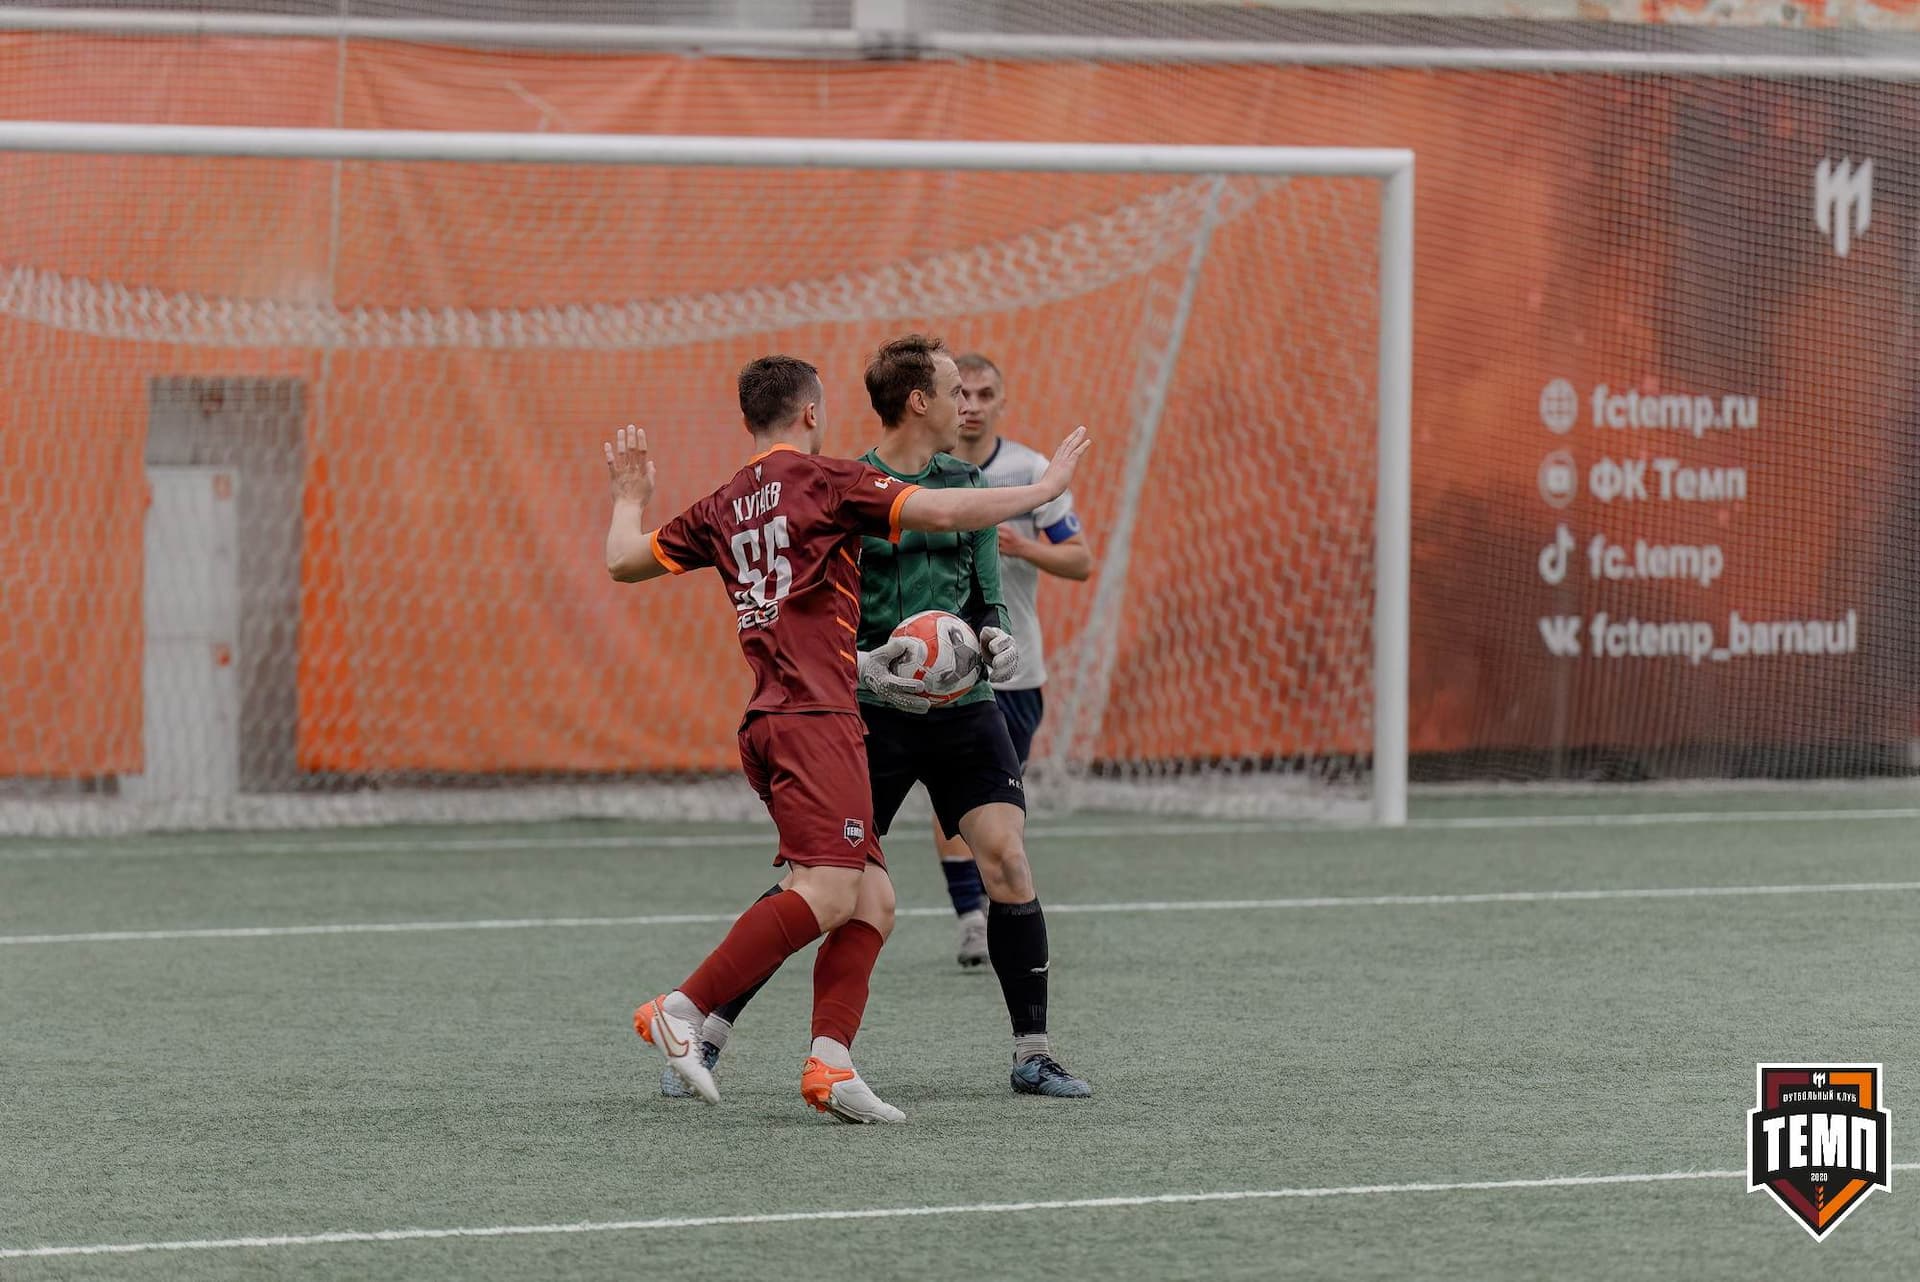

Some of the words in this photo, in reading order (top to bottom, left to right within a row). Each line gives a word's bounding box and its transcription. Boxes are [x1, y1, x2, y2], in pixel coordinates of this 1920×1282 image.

[1592, 383, 1758, 438] fctemp.ru
[1589, 457, 1648, 503] ФК
[1653, 459, 1748, 500] Темп
[1589, 534, 1724, 587] fc.temp
[1590, 608, 1857, 666] fctemp_barnaul
